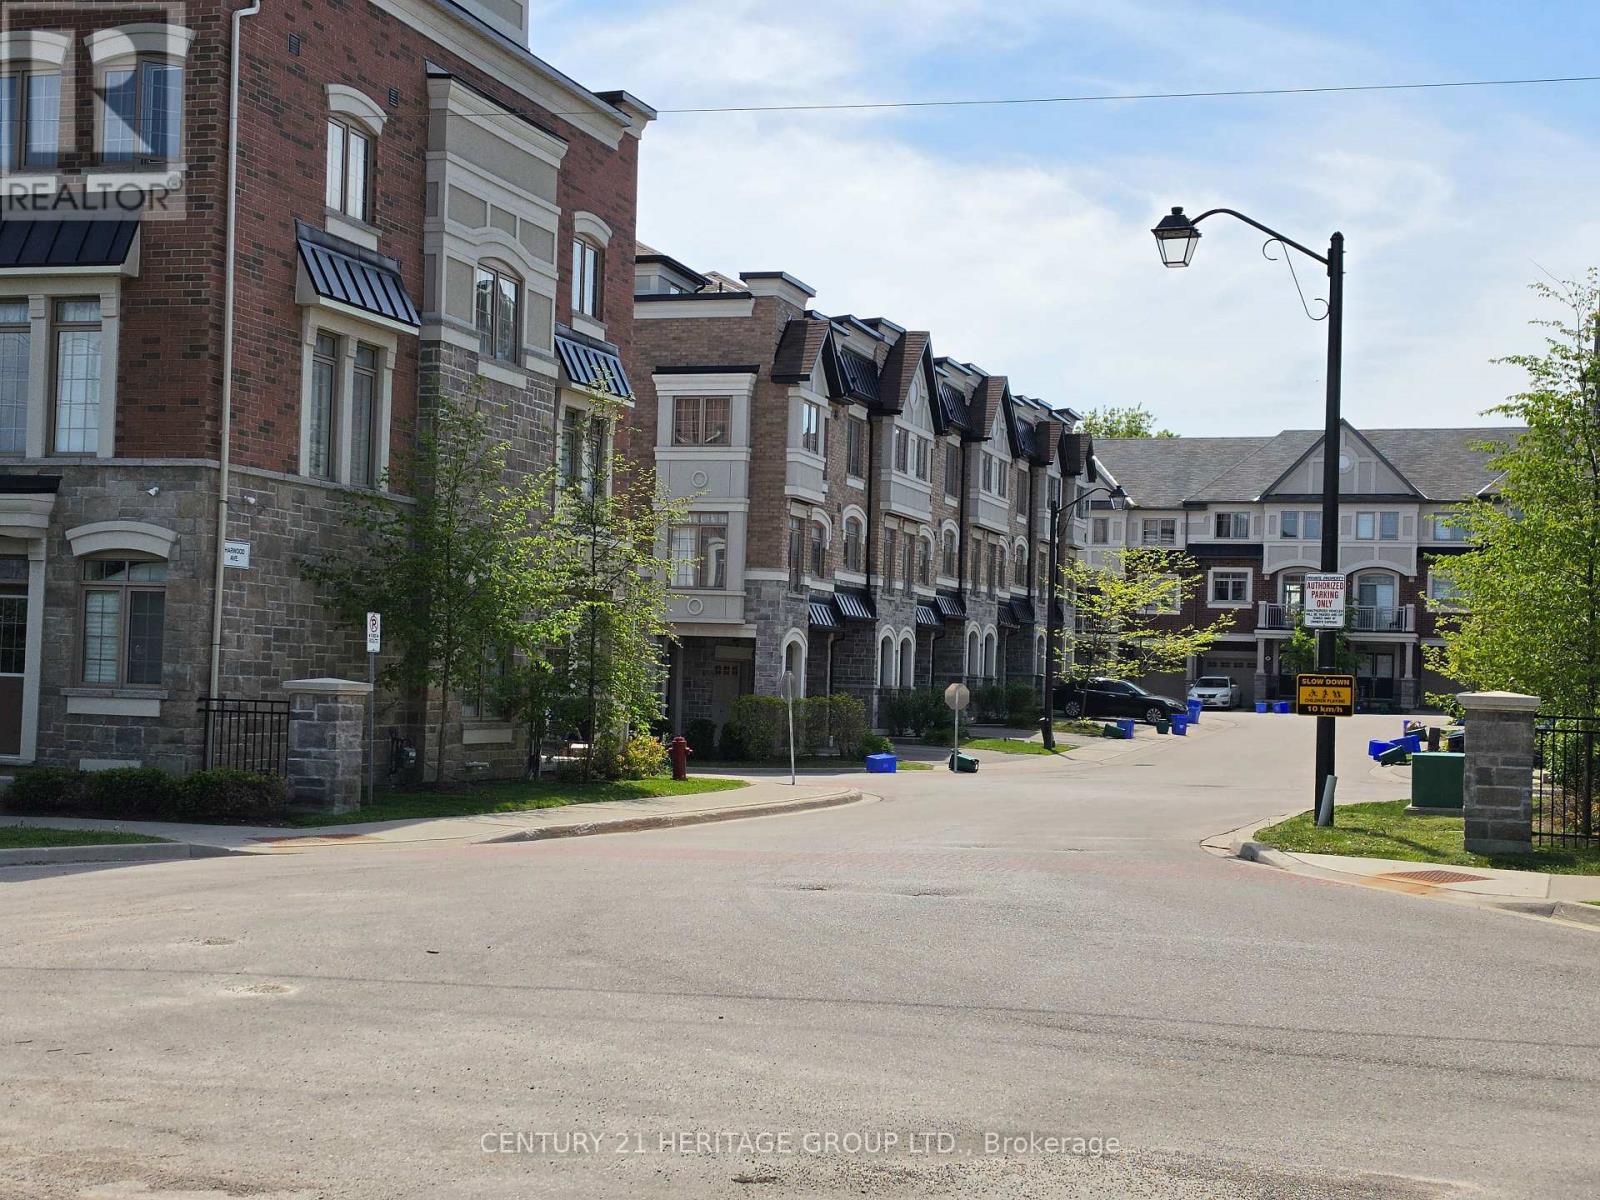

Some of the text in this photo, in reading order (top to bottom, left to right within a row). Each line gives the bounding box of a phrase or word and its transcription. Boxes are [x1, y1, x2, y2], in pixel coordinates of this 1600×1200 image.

[1307, 582, 1344, 590] AUTHORIZED
[1311, 591, 1339, 599] PARKING
[1316, 600, 1333, 608] ONLY
